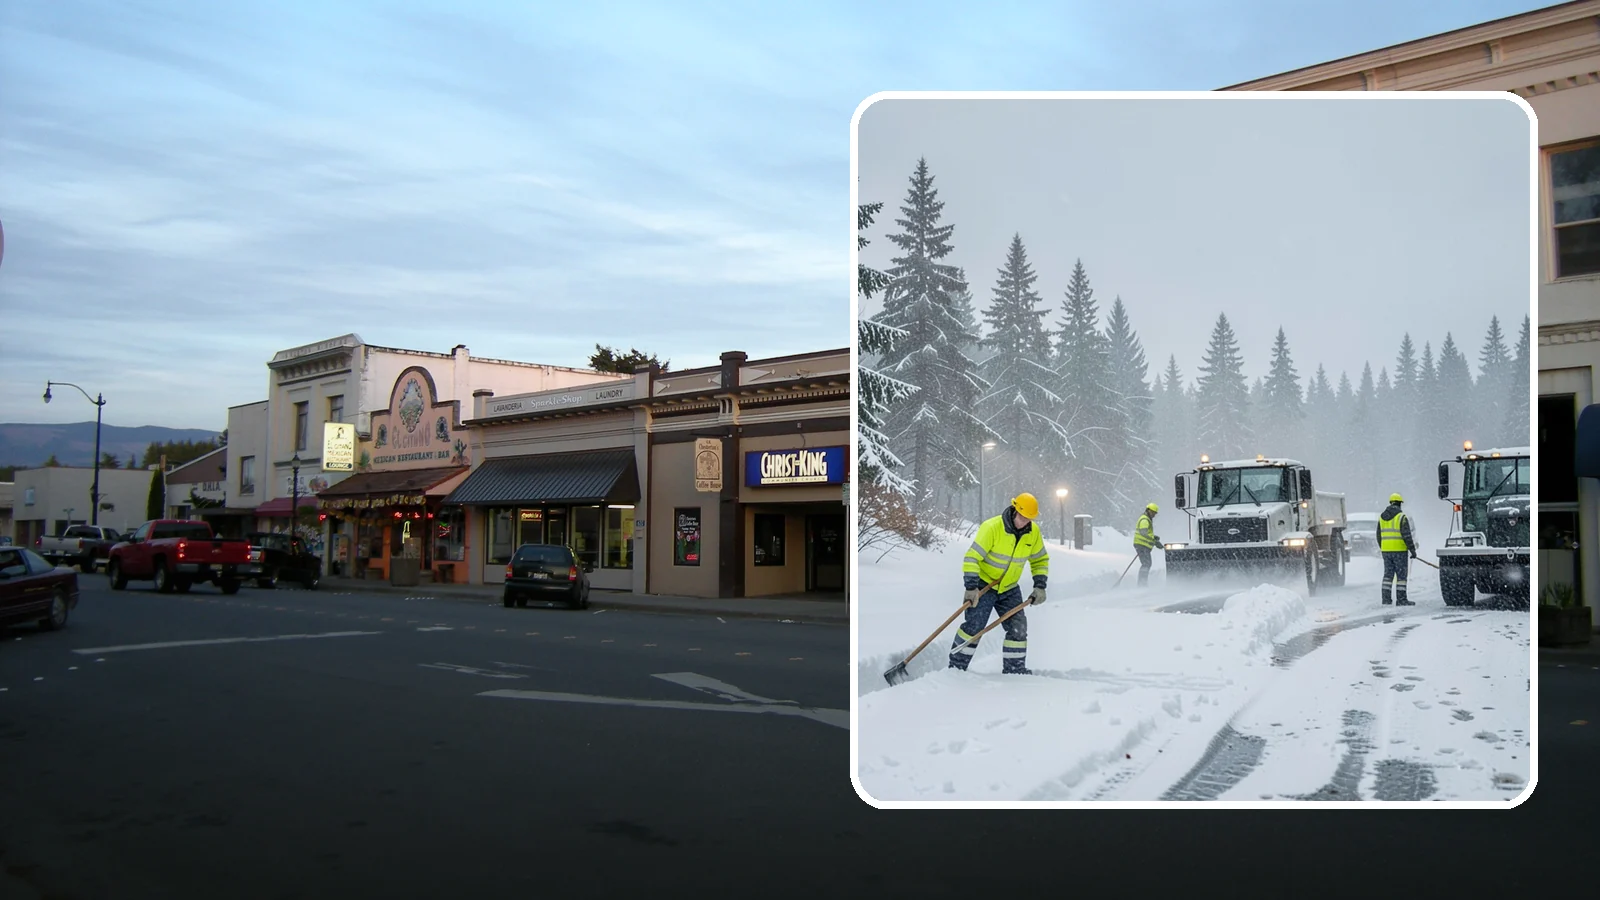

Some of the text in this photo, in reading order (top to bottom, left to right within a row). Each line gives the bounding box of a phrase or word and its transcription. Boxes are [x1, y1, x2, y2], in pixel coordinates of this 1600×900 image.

[561, 394, 582, 404] Shop
[595, 389, 623, 400] LAUNDRY
[493, 402, 522, 412] LAVANDERIA
[374, 455, 396, 463] MEXICAN
[398, 451, 433, 462] RESTAURANT
[438, 450, 450, 459] BAR
[761, 450, 827, 478] CHRIST KING
